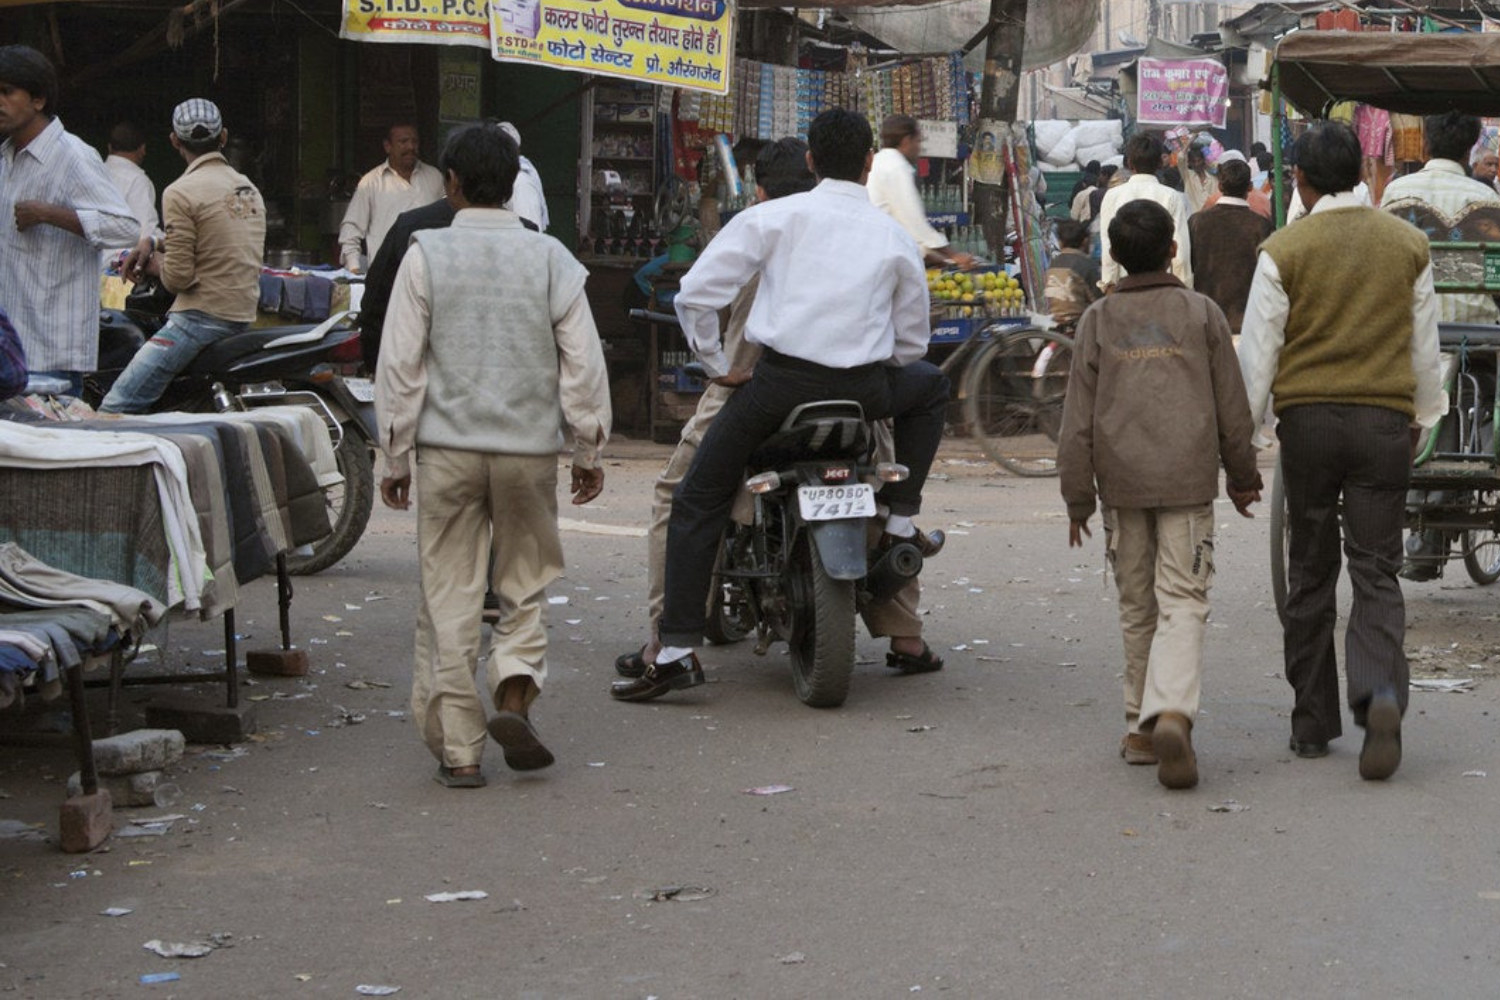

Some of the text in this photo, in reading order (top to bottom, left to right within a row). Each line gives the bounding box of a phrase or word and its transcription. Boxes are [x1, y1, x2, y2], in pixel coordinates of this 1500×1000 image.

[543, 6, 580, 31] कलर
[582, 6, 609, 37] फोटो
[504, 36, 529, 49] STD
[546, 38, 587, 60] फोटो
